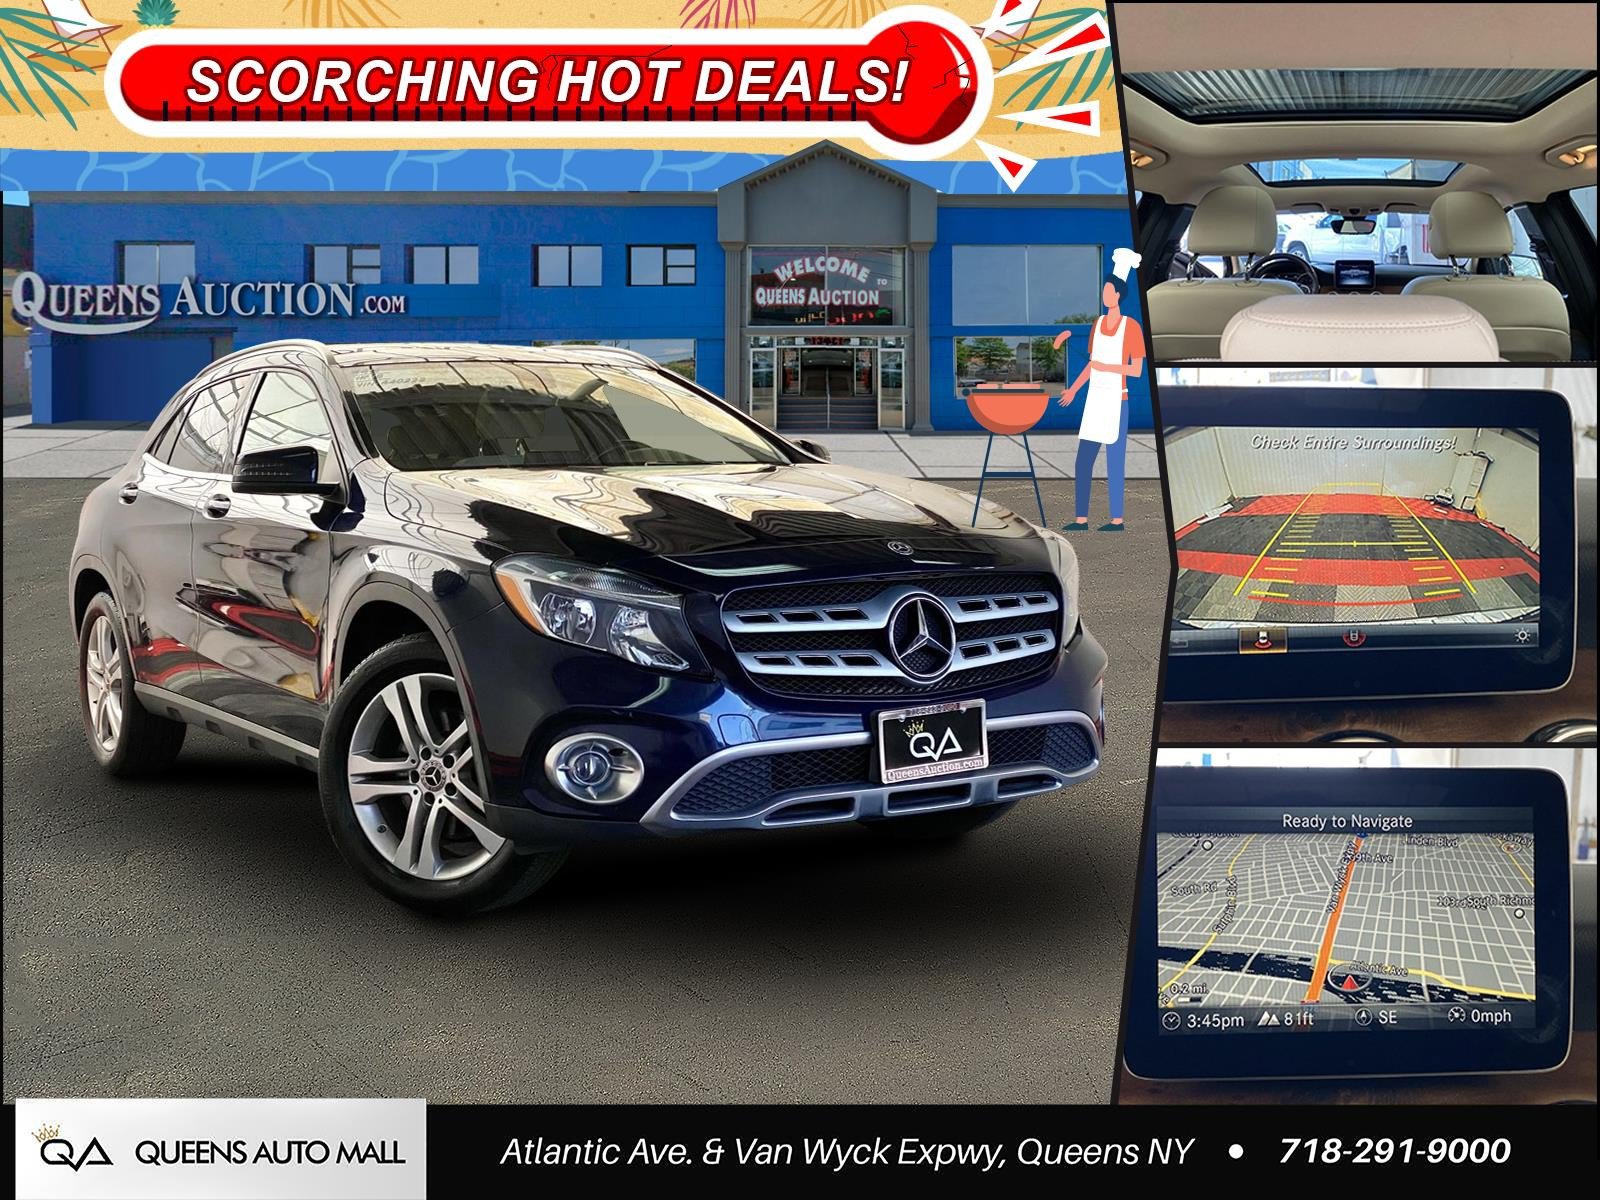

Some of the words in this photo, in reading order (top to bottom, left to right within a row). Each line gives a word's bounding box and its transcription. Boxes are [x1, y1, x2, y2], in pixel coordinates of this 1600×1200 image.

[773, 255, 870, 284] WELCOME
[12, 271, 160, 335] QUEENS
[170, 276, 356, 318] AUCTION
[755, 287, 806, 306] QUEENS
[808, 287, 880, 306] AUCTION
[1251, 434, 1299, 450] Check
[1304, 434, 1348, 450] Entire
[1353, 434, 1458, 453] Surroundings!
[887, 759, 984, 782] QueensAuction.com
[1282, 813, 1328, 831] Ready
[1332, 815, 1347, 828] to
[1351, 813, 1414, 832] Navigate
[1374, 853, 1394, 864] Ave
[1171, 885, 1200, 897] South
[1170, 983, 1190, 994] 0.2
[1192, 983, 1209, 994] mi.
[1187, 1014, 1245, 1030] 3:45pm
[1284, 1011, 1315, 1026] 81ft
[1378, 1010, 1398, 1025] SE
[1471, 1008, 1512, 1026] 0mph
